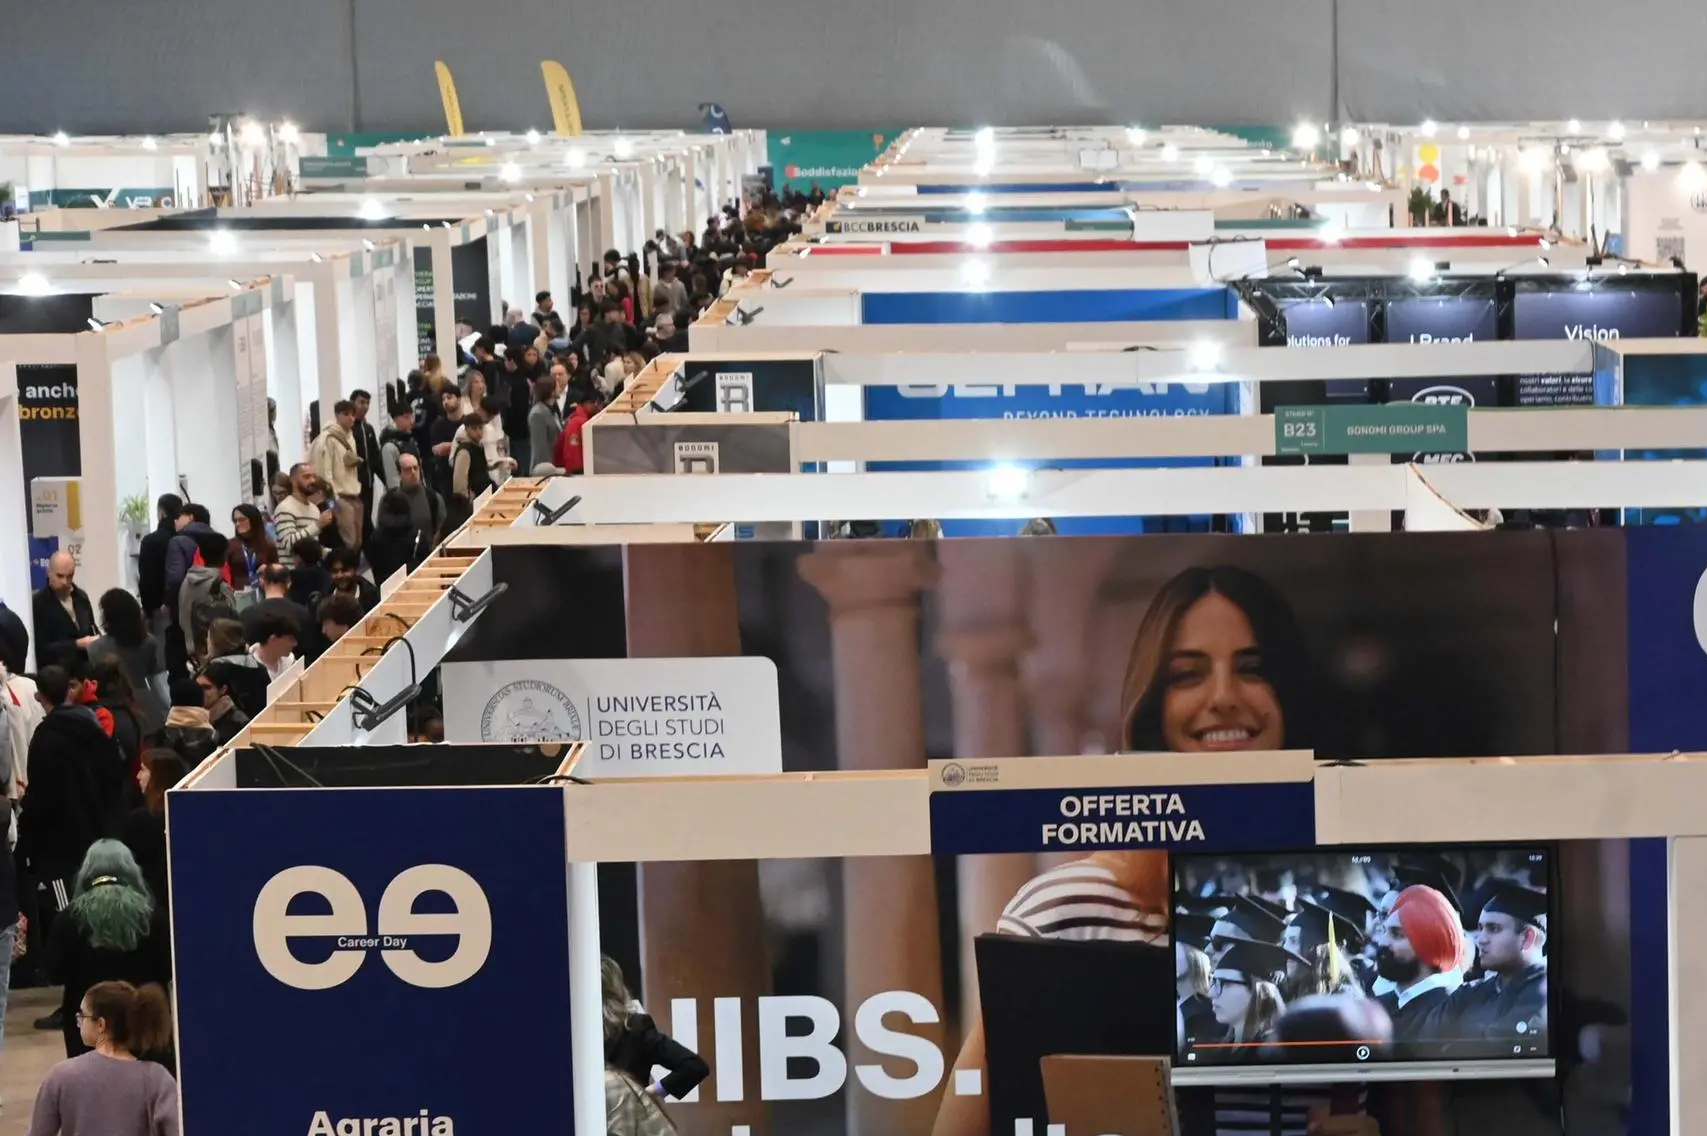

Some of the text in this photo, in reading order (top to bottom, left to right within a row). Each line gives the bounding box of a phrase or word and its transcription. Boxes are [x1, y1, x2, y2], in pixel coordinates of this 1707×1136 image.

[843, 221, 920, 232] BCCBRESCIA
[1564, 325, 1620, 341] Vision
[1284, 423, 1316, 437] B23
[1389, 425, 1424, 435] GROUP
[597, 692, 722, 713] UNIVERSITÀ
[599, 719, 724, 736] DEGLI STUDI
[600, 743, 725, 760] DI BRESCIA
[1059, 794, 1186, 817] OFFERTA
[1042, 820, 1206, 845] FORMATIVA
[337, 935, 408, 950] Career Day
